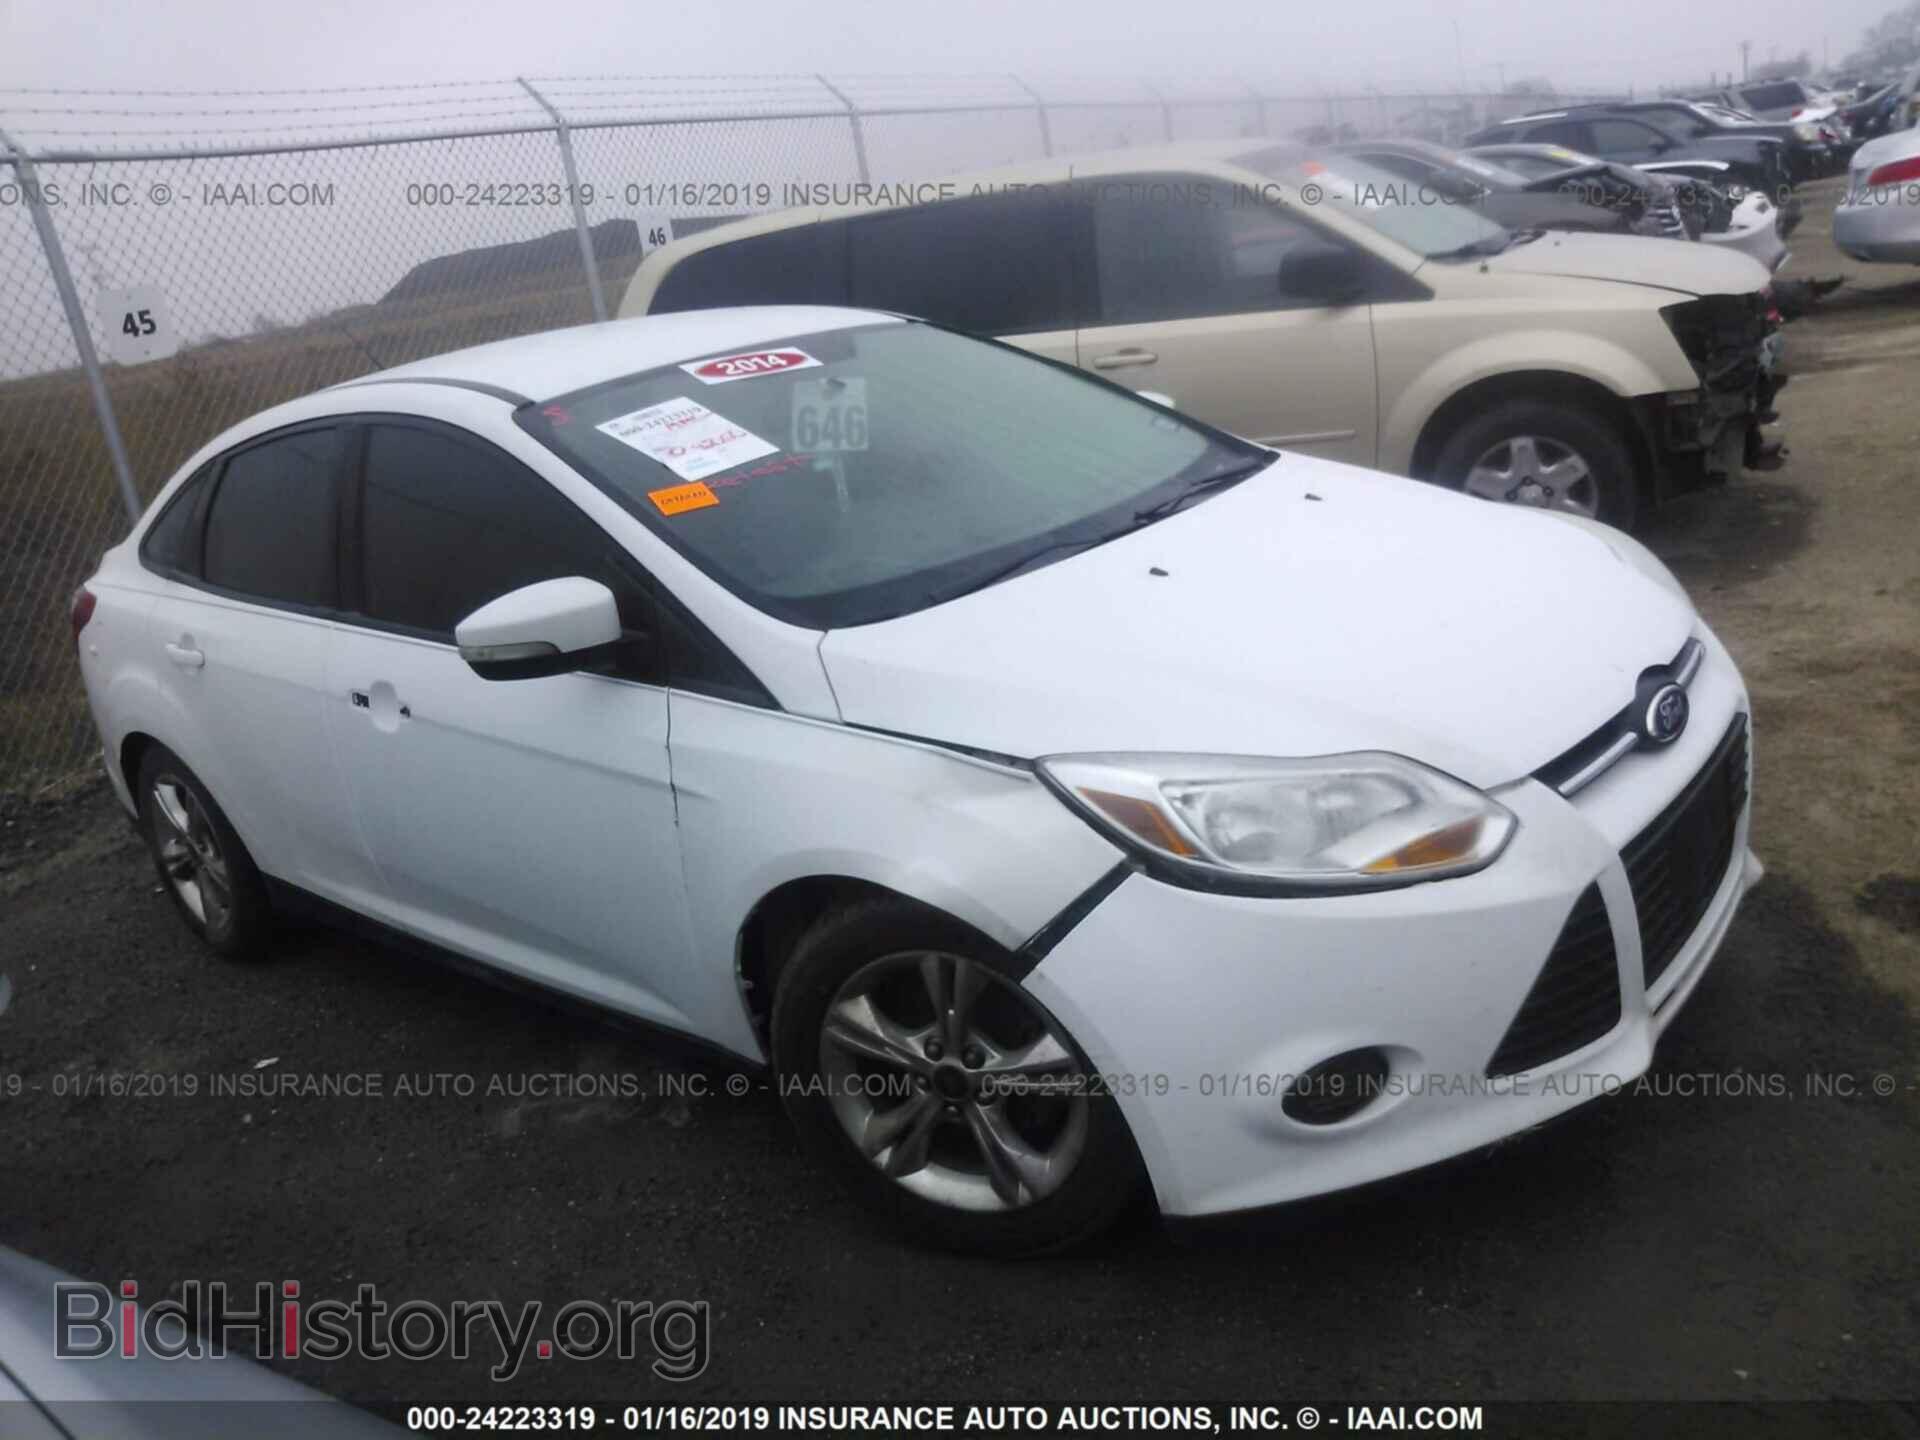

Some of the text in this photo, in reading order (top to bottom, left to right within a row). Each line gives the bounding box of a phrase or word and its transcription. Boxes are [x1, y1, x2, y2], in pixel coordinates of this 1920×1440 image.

[648, 227, 667, 247] 46
[122, 308, 157, 338] 45
[716, 353, 788, 376] 2014
[796, 404, 868, 450] 646
